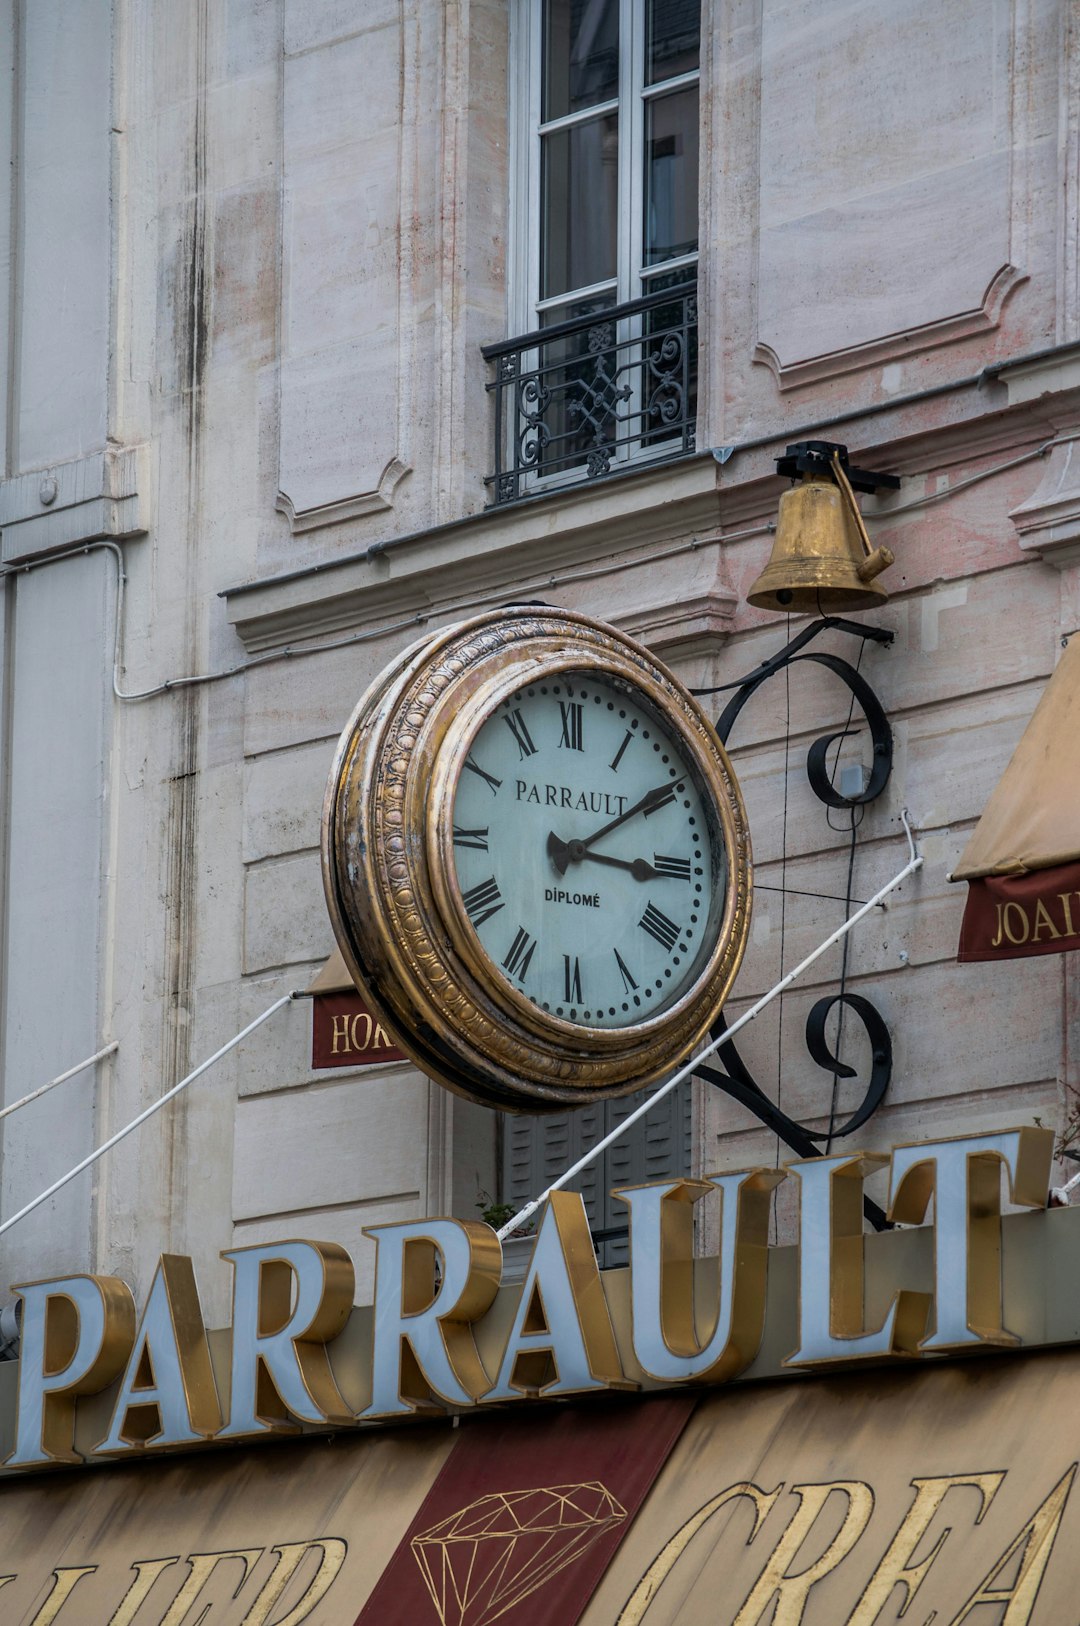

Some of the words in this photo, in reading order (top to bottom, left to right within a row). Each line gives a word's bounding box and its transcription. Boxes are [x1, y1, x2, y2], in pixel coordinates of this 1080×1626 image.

[501, 708, 539, 761] XI
[557, 701, 585, 752] XII
[608, 729, 635, 773] I
[464, 752, 503, 797] X
[515, 780, 628, 817] PARRAULT
[453, 825, 489, 853] IX
[654, 852, 691, 884] III
[462, 874, 505, 931] VIII
[637, 900, 682, 954] IIII
[991, 891, 1080, 947] JOAI
[501, 925, 537, 984] VII
[562, 954, 585, 1004] VI
[613, 947, 640, 995] V
[2, 1127, 1053, 1468] PARRAULT
